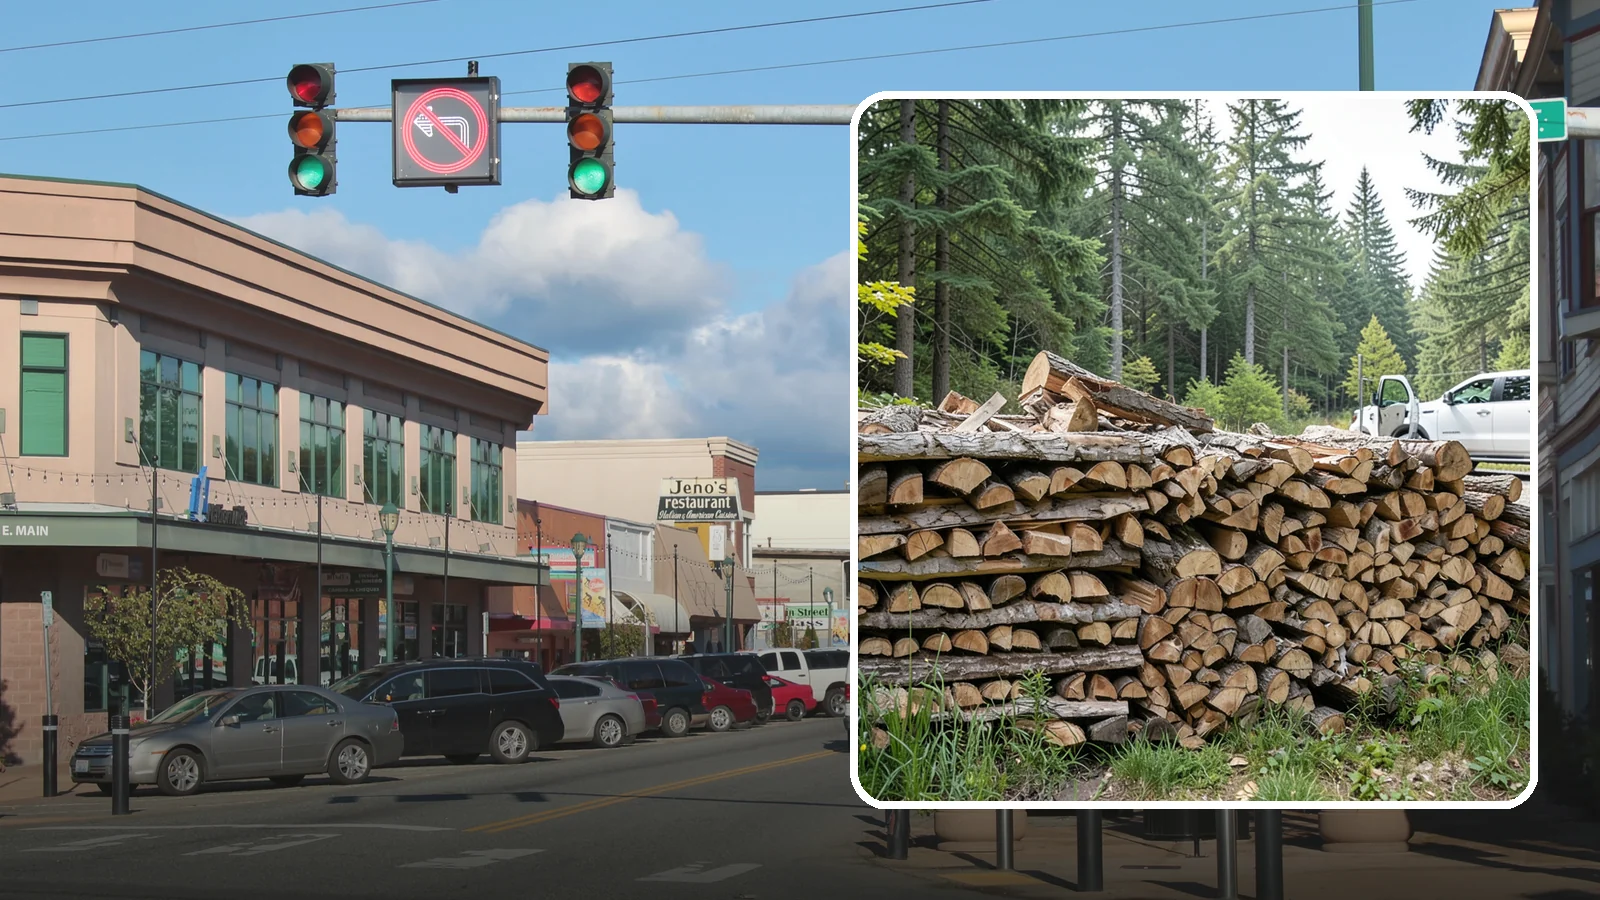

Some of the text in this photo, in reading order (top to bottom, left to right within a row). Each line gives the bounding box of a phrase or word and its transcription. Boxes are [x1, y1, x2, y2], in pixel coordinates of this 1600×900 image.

[670, 480, 727, 494] Jeno's
[665, 496, 730, 508] restaurant
[658, 510, 681, 519] Italian
[685, 510, 714, 519] American
[715, 509, 737, 519] Cuisine
[2, 525, 49, 536] E. MAIN
[786, 607, 795, 616] in
[797, 607, 828, 616] Street
[791, 619, 823, 627] lass
